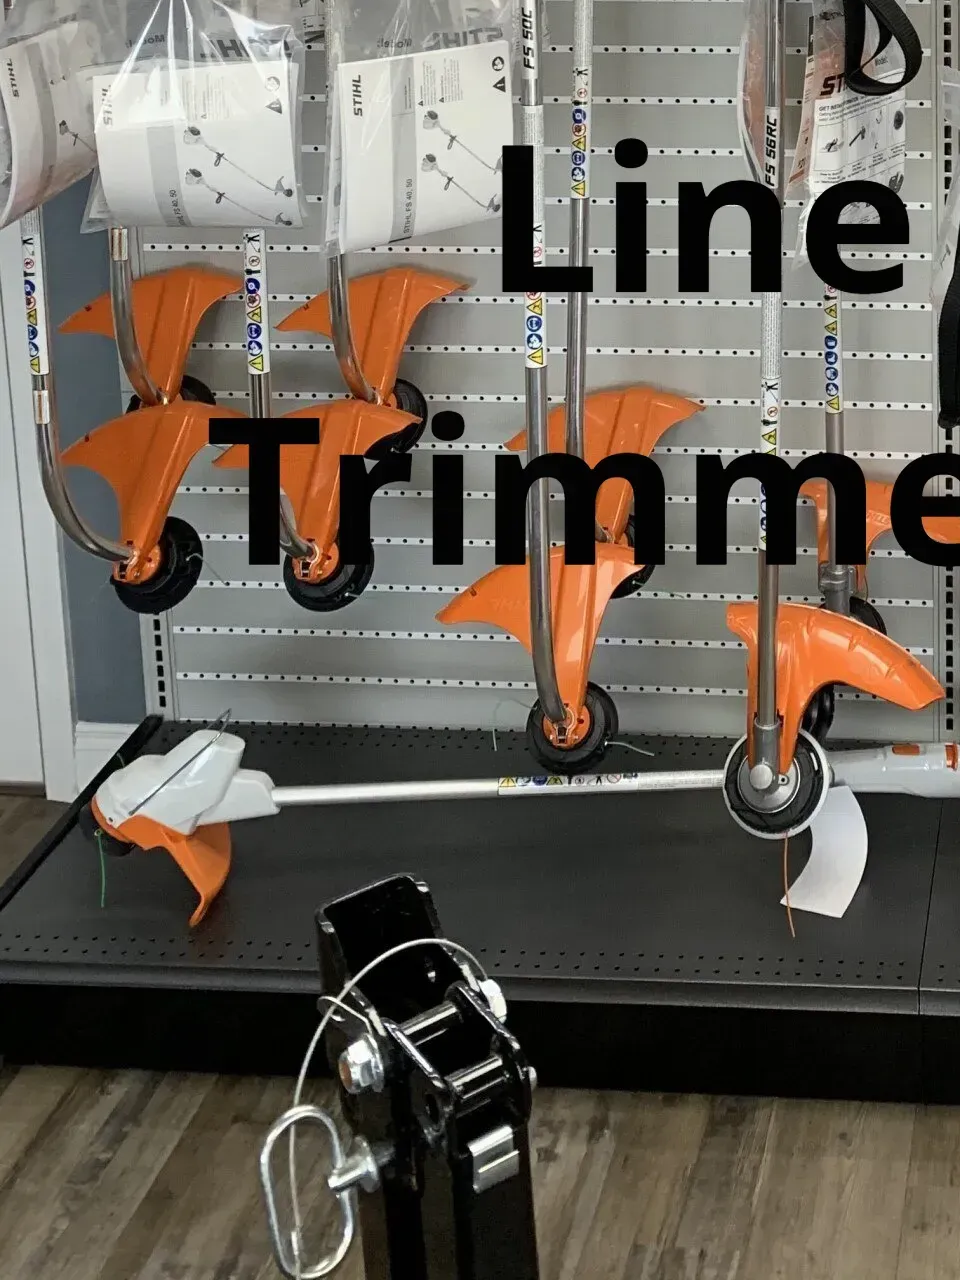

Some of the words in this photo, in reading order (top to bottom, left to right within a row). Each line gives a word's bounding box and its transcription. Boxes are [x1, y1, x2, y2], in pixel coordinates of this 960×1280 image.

[522, 8, 533, 41] 50C
[524, 46, 535, 70] FS
[352, 74, 363, 117] STIHL
[766, 115, 777, 160] 56RC
[765, 162, 776, 187] FS
[405, 202, 413, 212] FS
